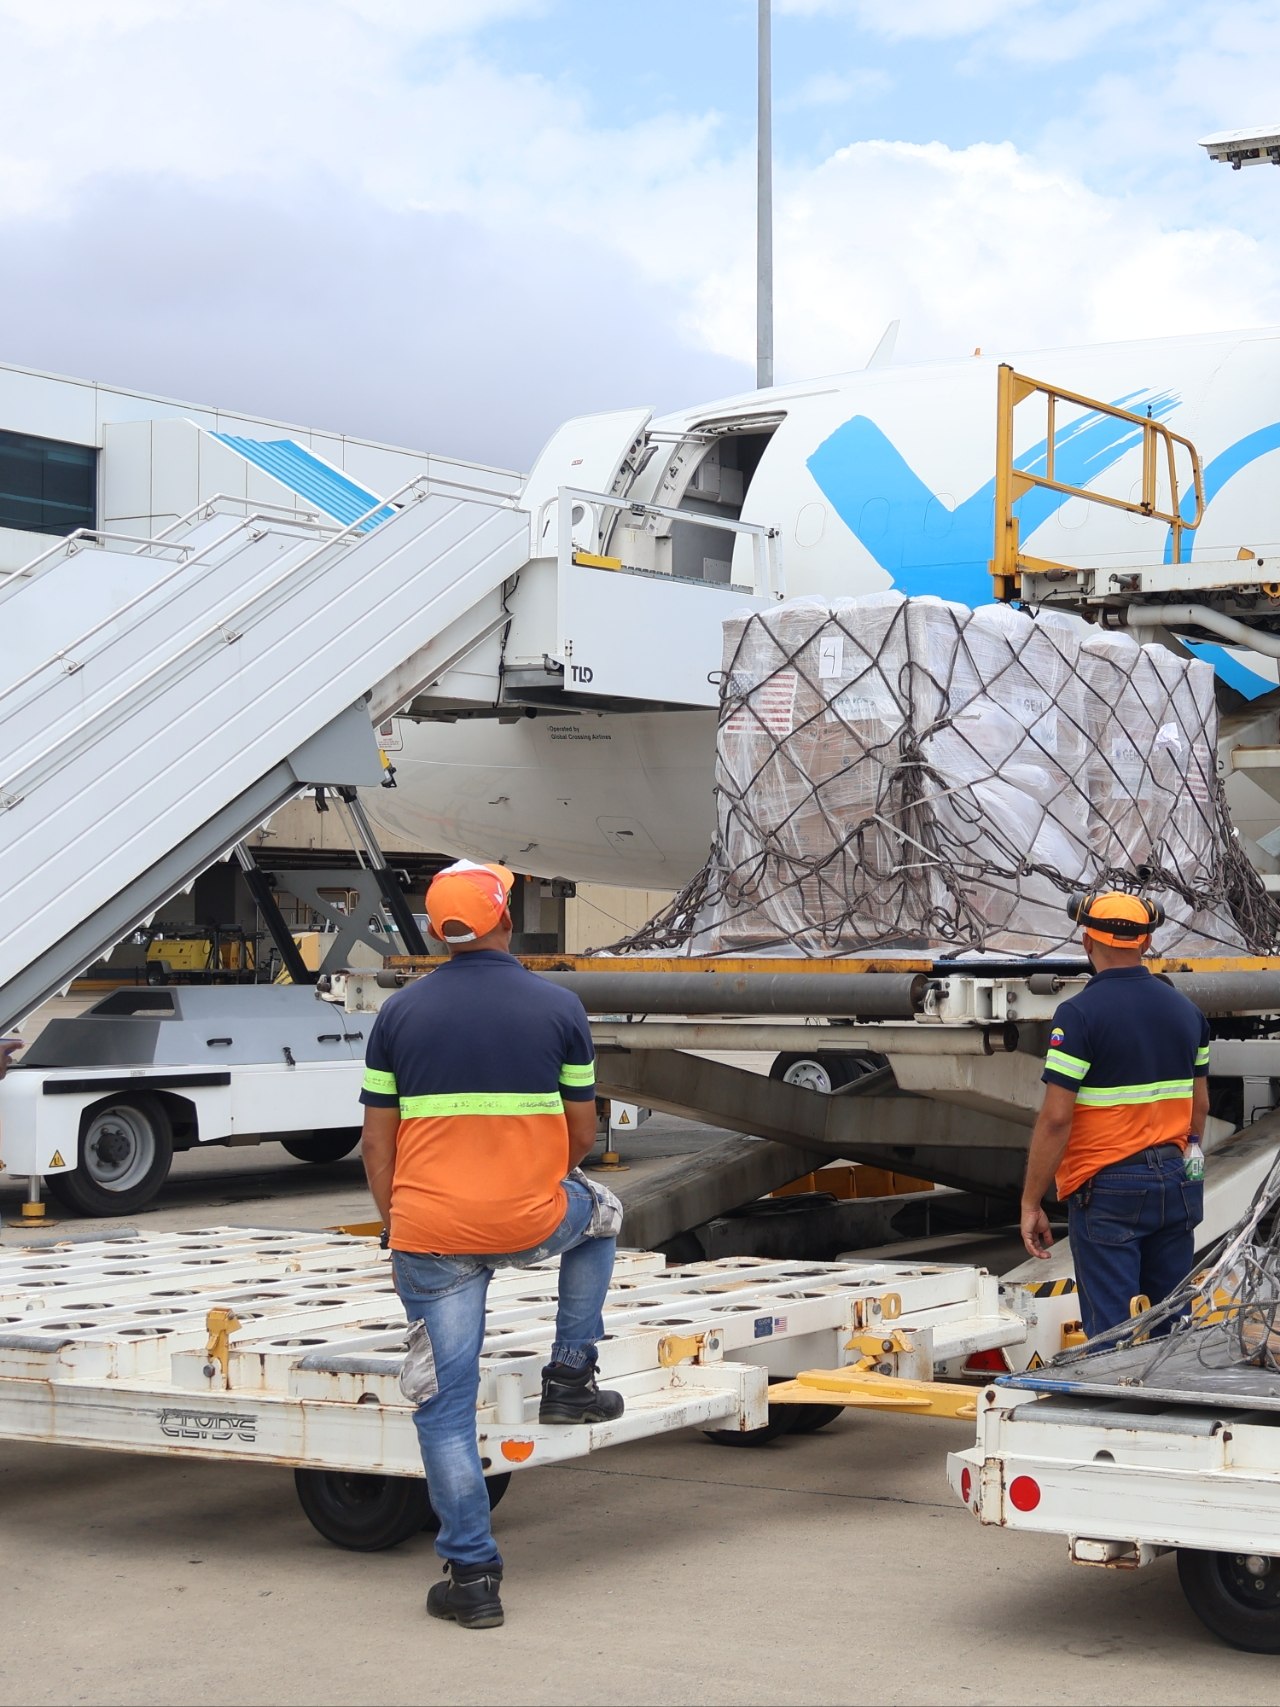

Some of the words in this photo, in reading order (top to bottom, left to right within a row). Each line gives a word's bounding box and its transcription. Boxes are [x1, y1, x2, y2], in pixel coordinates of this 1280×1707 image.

[823, 645, 836, 675] 4
[571, 665, 594, 683] TLD
[573, 725, 580, 733] by
[568, 733, 591, 741] Crossing
